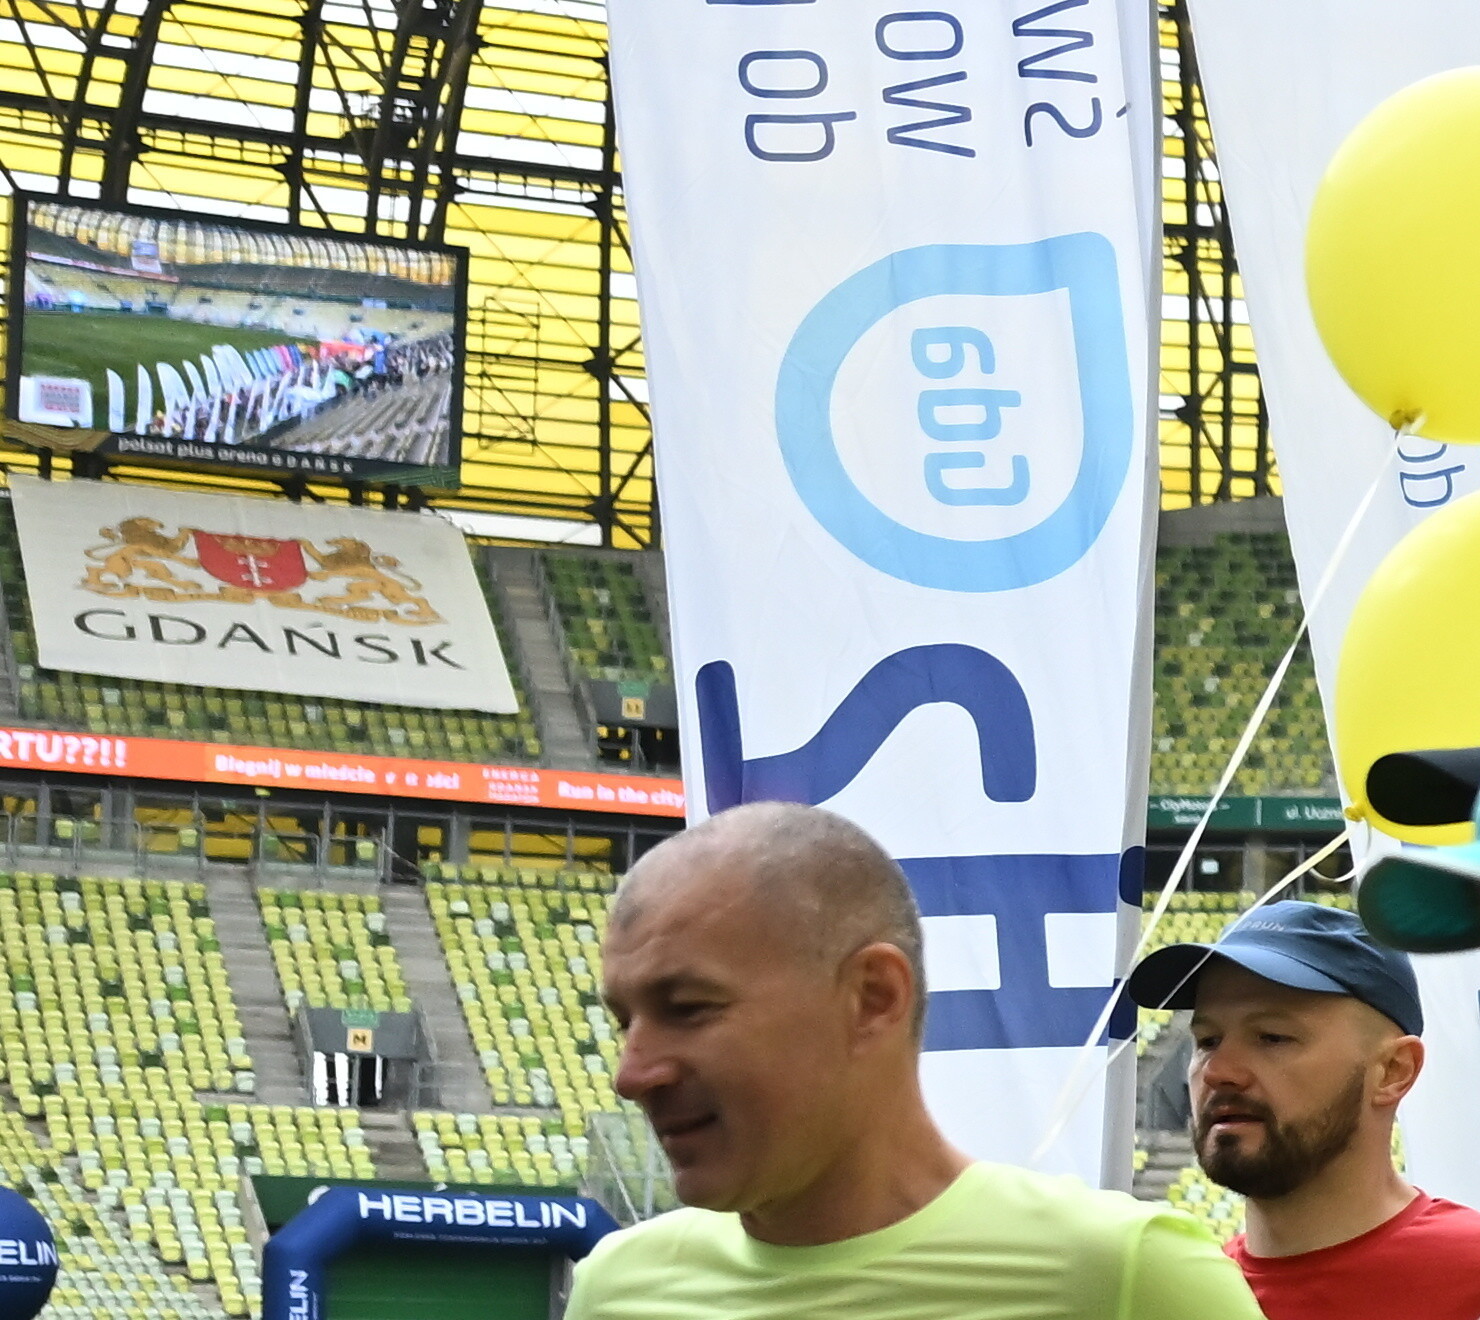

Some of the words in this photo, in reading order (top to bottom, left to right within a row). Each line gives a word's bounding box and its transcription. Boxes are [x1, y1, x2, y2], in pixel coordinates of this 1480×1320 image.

[178, 442, 215, 461] plus
[73, 608, 467, 671] GDAŃSK
[358, 1192, 588, 1229] HERBELIN
